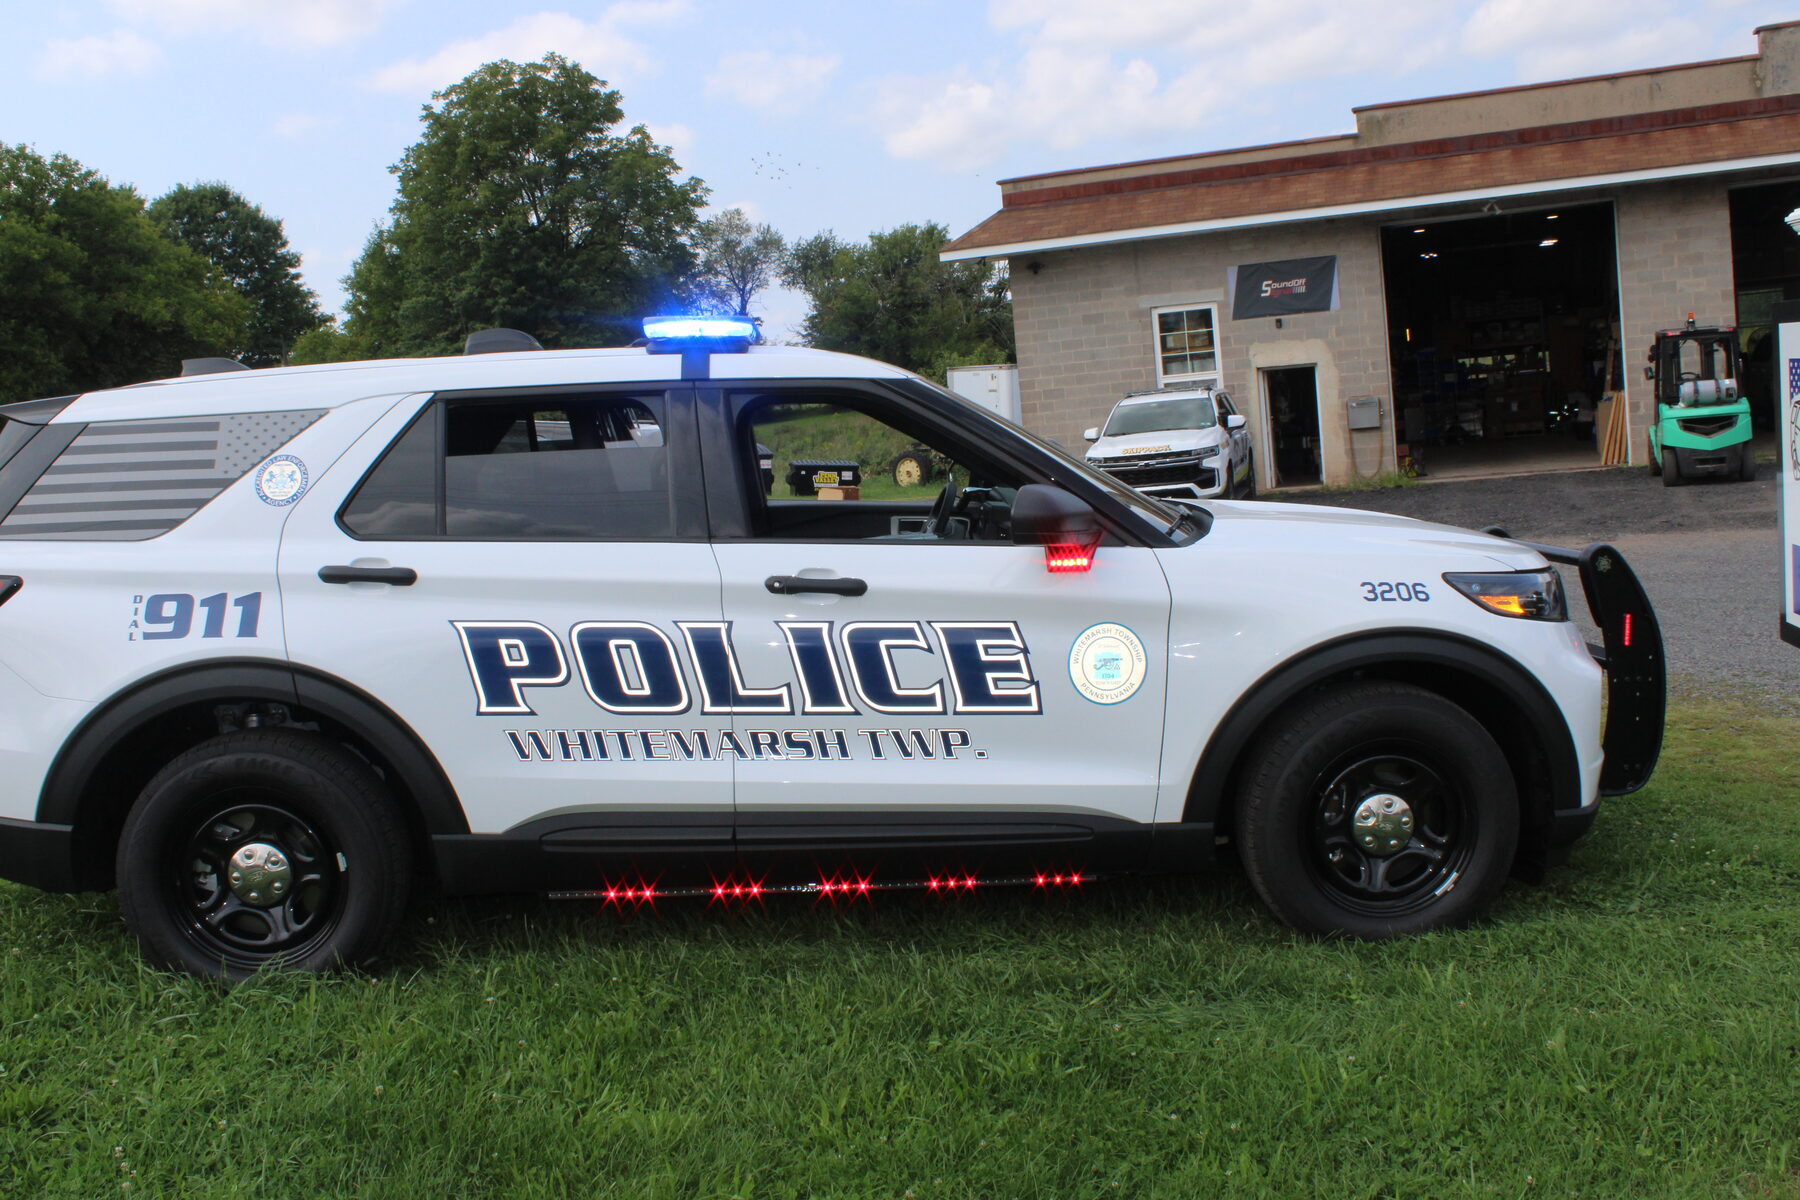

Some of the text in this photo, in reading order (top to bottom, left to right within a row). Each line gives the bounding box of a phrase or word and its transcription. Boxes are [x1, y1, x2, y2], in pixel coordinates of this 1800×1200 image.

[266, 498, 293, 507] AGENCY
[1360, 582, 1430, 602] 3206
[128, 591, 262, 641] DIAL 911
[1073, 627, 1143, 665] WHITEMARSH TOWNSHIP
[448, 620, 1043, 716] POLICE
[1081, 682, 1135, 700] PENNSYLVANIA
[504, 729, 988, 761] WHITEMARSH TWP.
